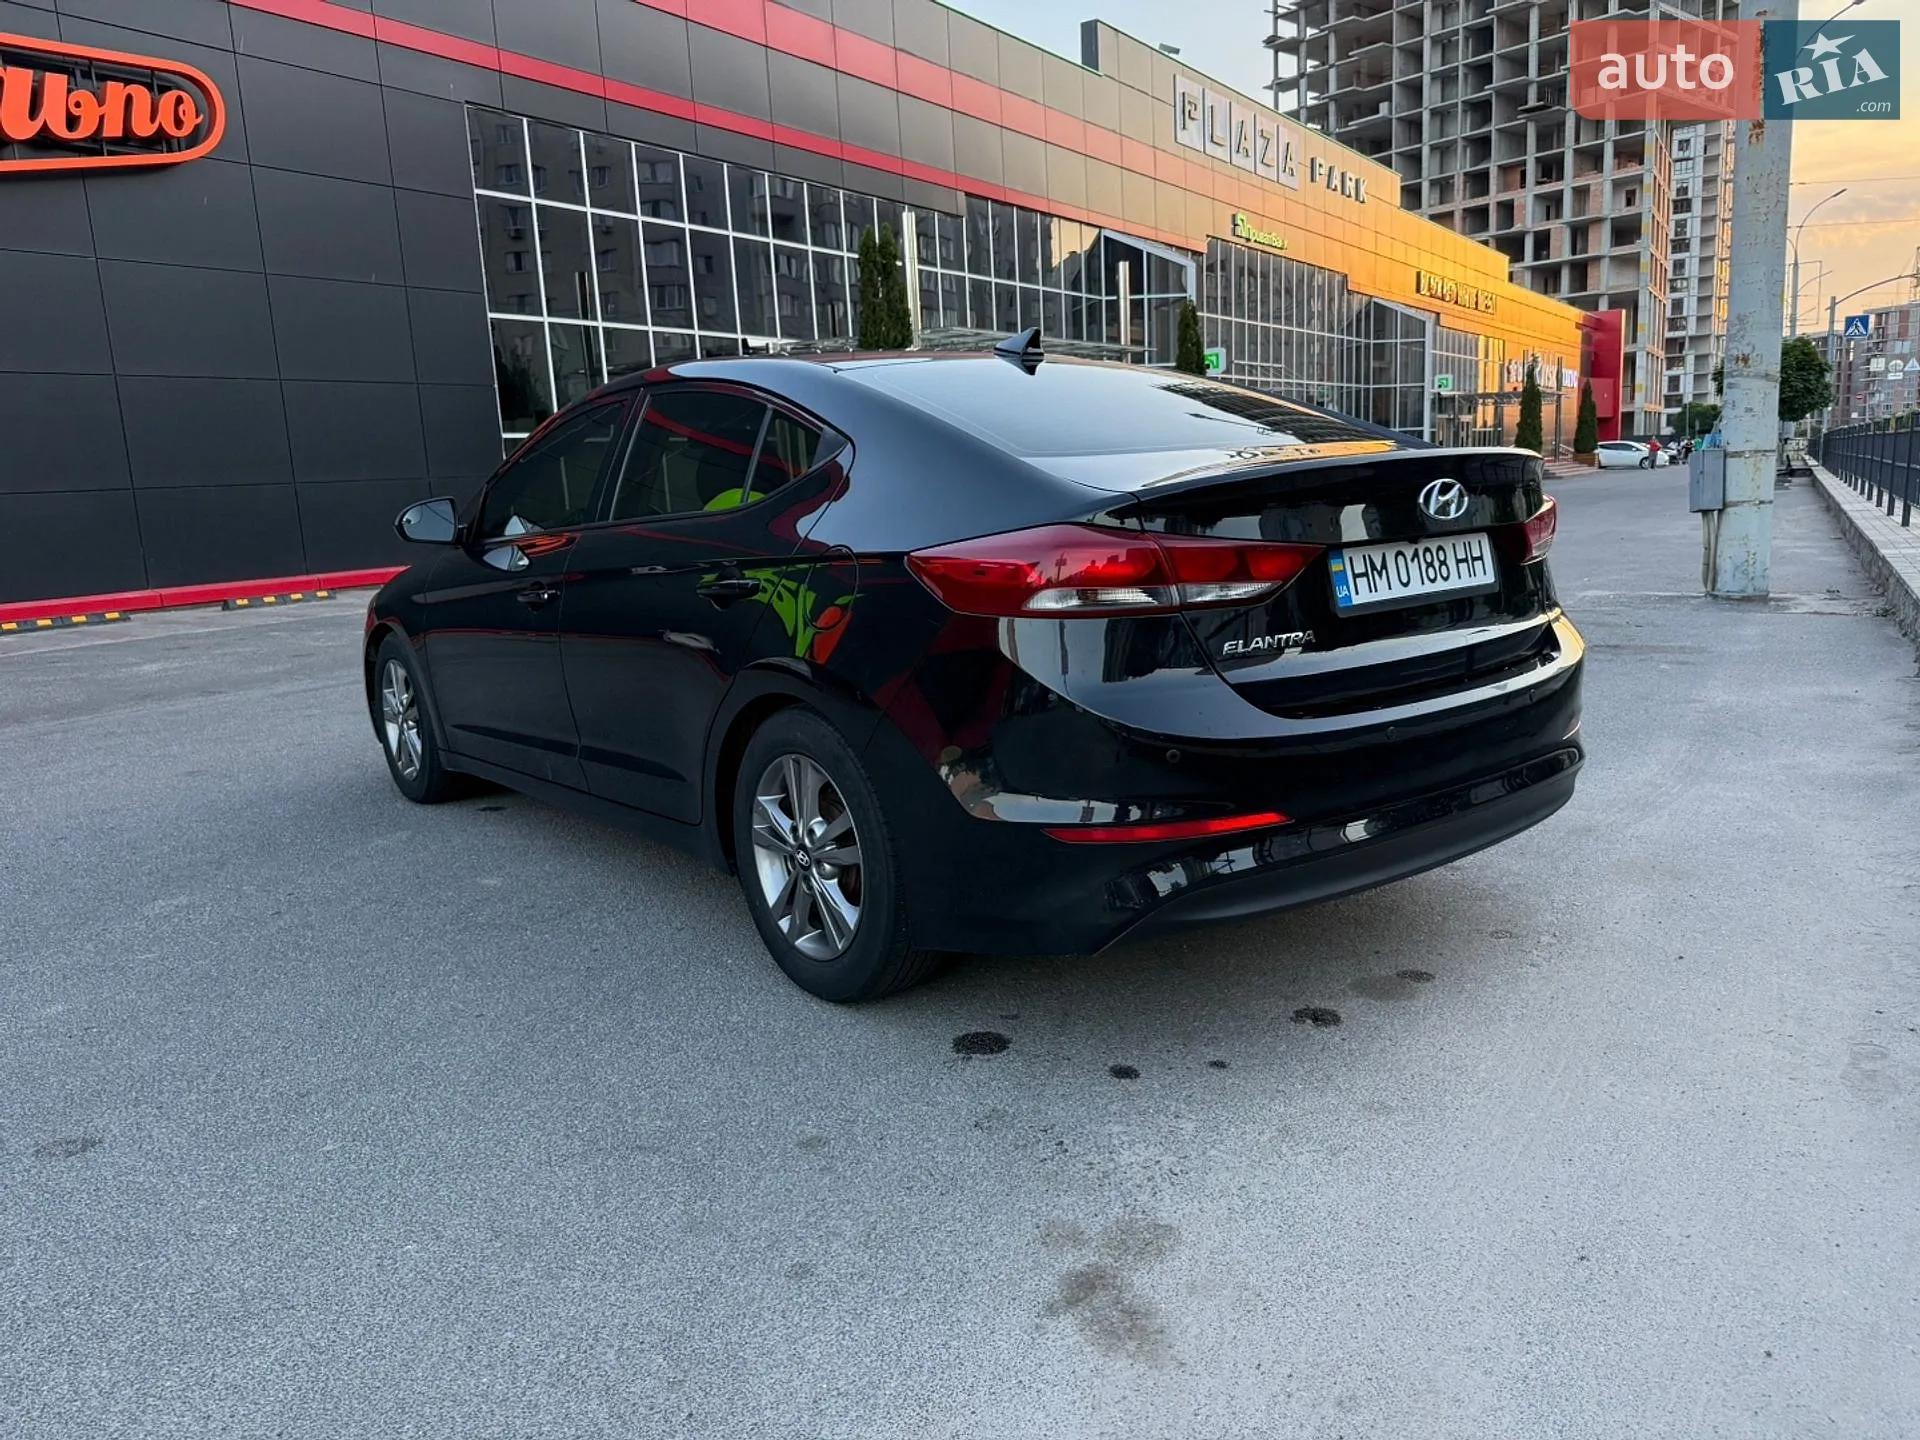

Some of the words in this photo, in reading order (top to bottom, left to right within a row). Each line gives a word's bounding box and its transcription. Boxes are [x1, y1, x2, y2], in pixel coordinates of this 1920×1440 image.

[1181, 90, 1297, 177] PLAZA
[1310, 156, 1369, 204] PARK
[1348, 552, 1392, 595] HM
[1394, 544, 1450, 588] 0188
[1452, 539, 1487, 580] HH
[1336, 584, 1350, 598] UA
[1222, 630, 1316, 656] ELANTRA
